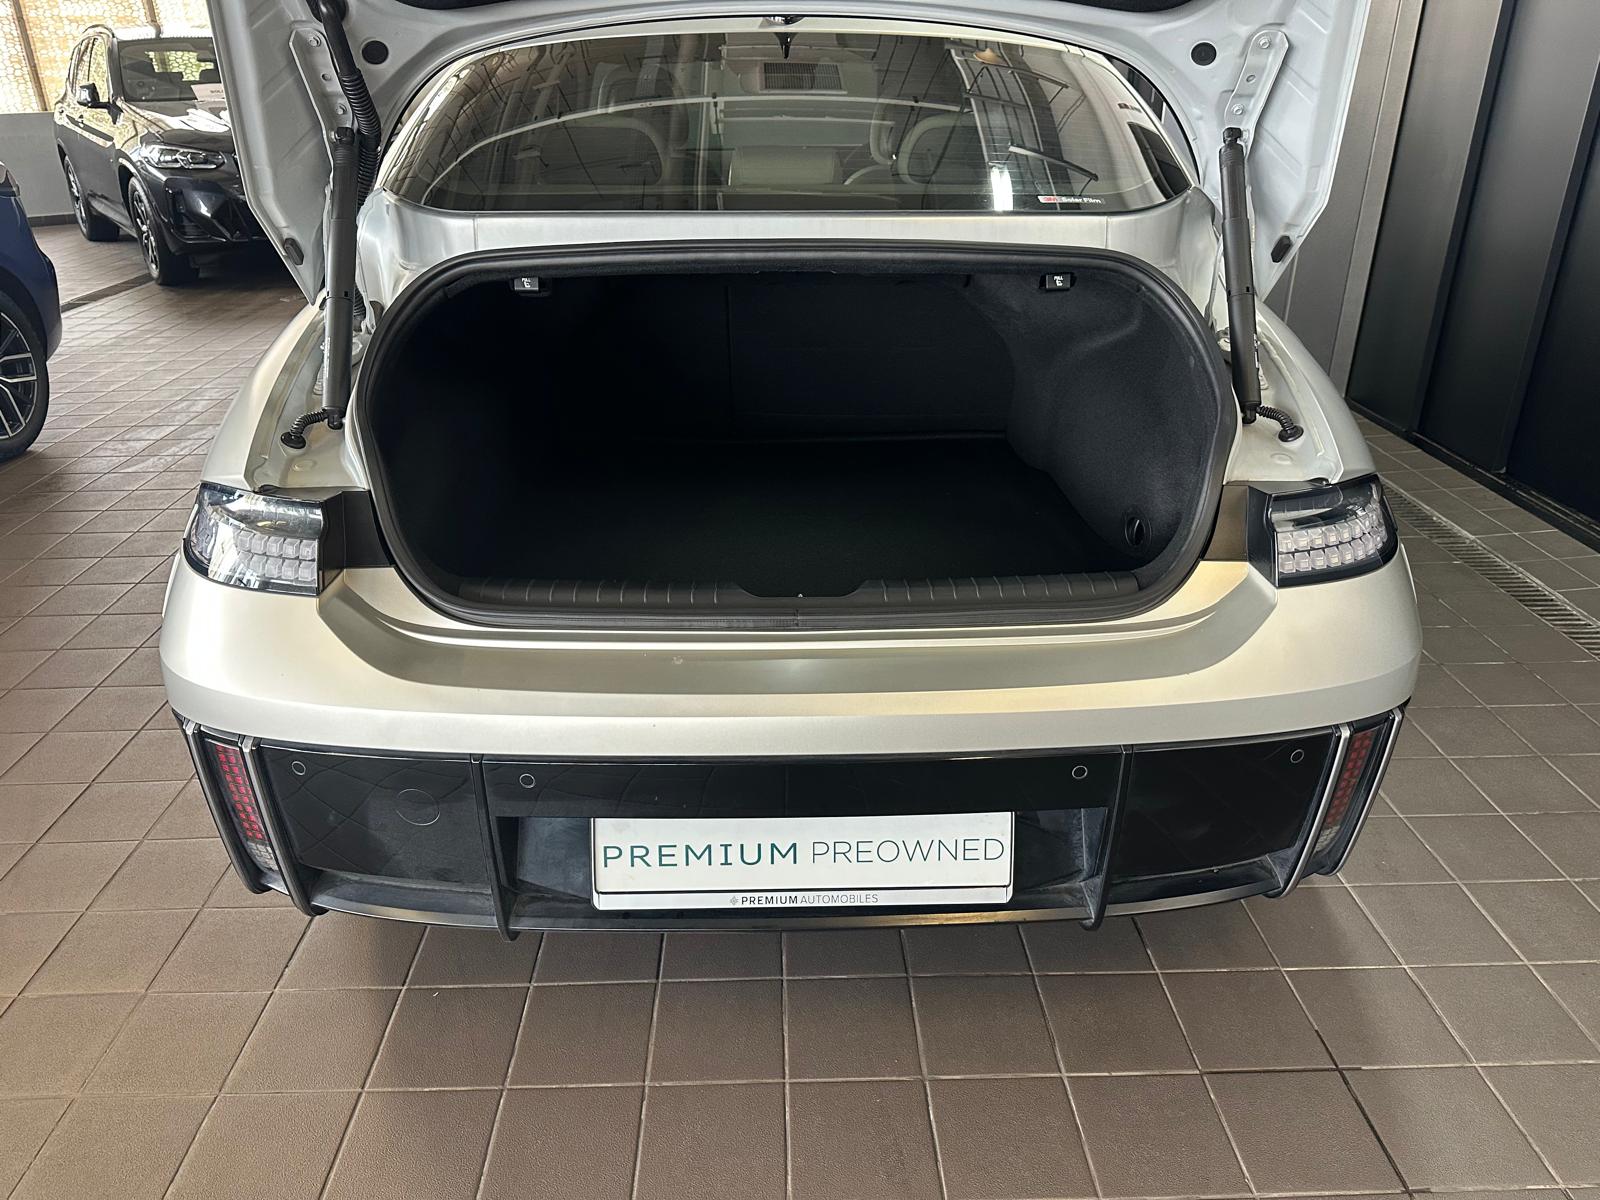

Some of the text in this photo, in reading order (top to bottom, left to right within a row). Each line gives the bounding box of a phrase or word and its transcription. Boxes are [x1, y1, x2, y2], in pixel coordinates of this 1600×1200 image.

[603, 838, 1005, 868] PREMIUM PREOWNED
[741, 893, 879, 905] PREMIUM AUTOMOBILES
